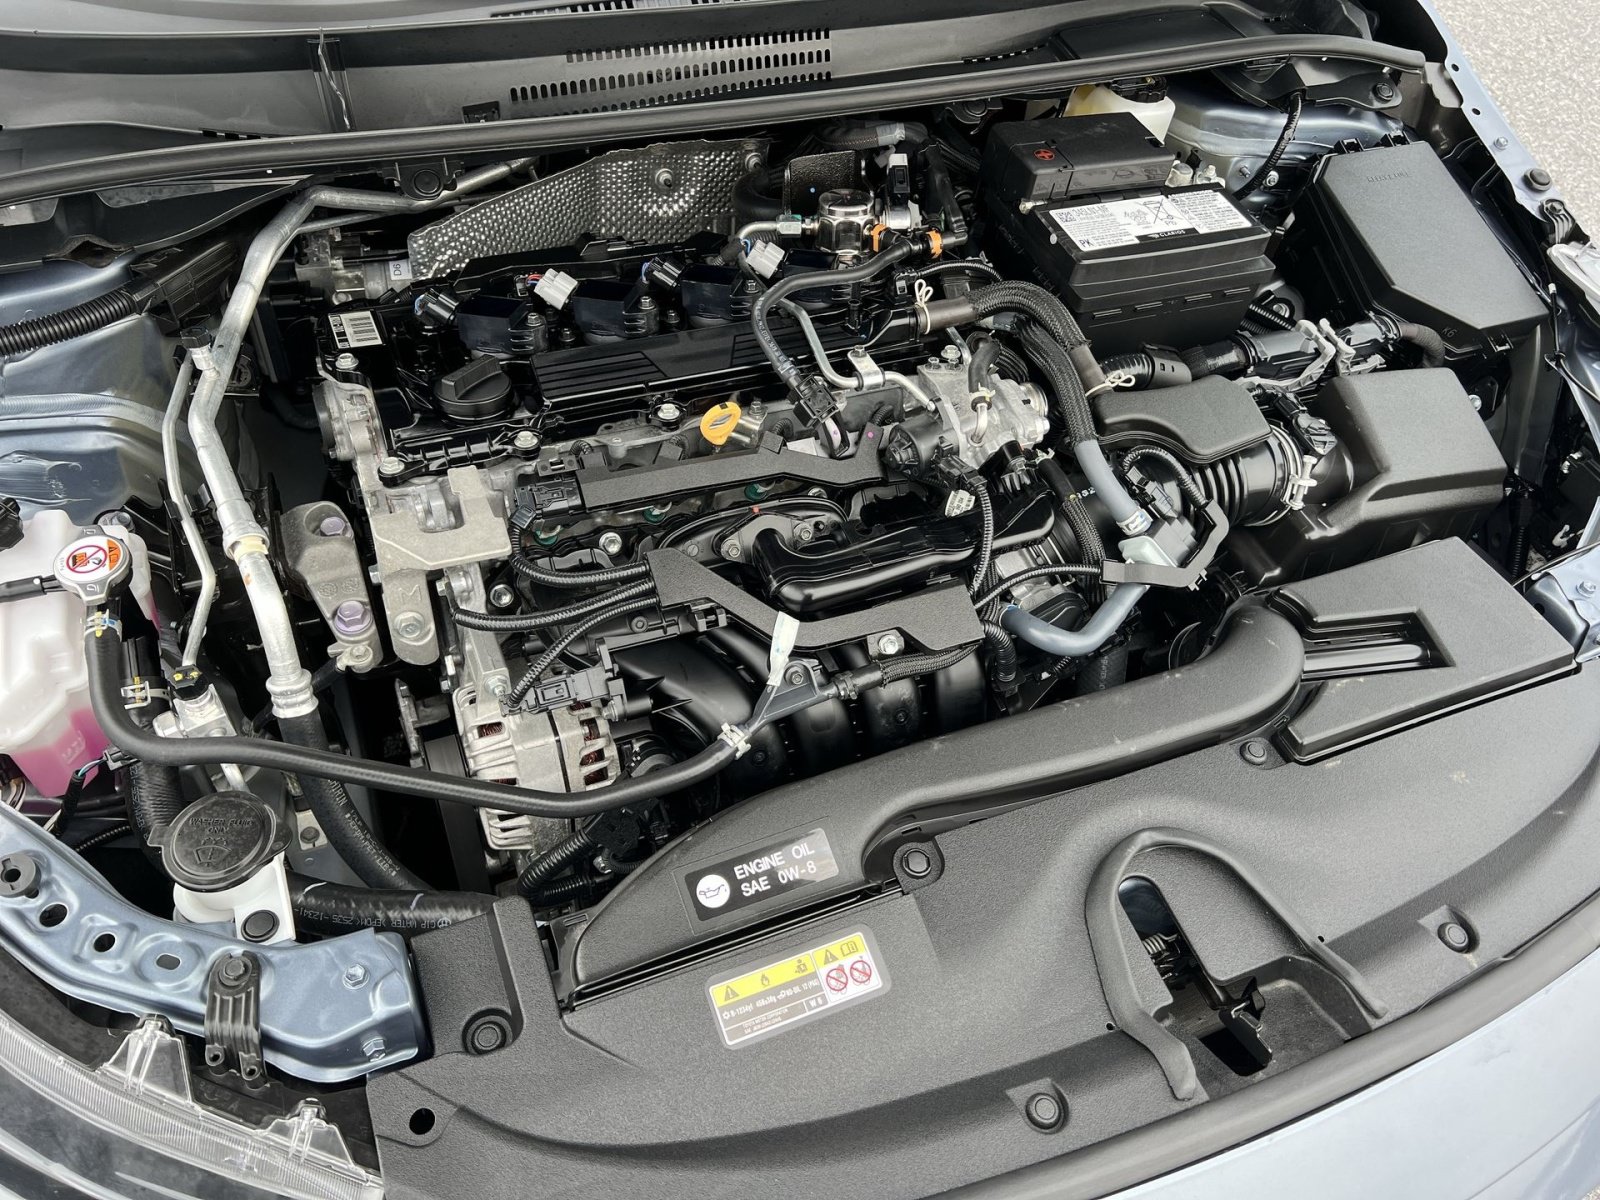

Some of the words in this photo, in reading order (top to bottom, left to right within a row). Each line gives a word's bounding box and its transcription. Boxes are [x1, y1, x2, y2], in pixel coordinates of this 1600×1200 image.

[1159, 229, 1186, 238] CLARIOS
[394, 263, 402, 276] D6
[328, 779, 348, 807] HIRIN
[189, 817, 226, 826] WASHER
[228, 817, 254, 826] FLUID
[733, 851, 785, 880] ENGINE
[792, 842, 815, 860] OIL
[740, 877, 771, 897] SAE
[391, 920, 417, 928] WATER
